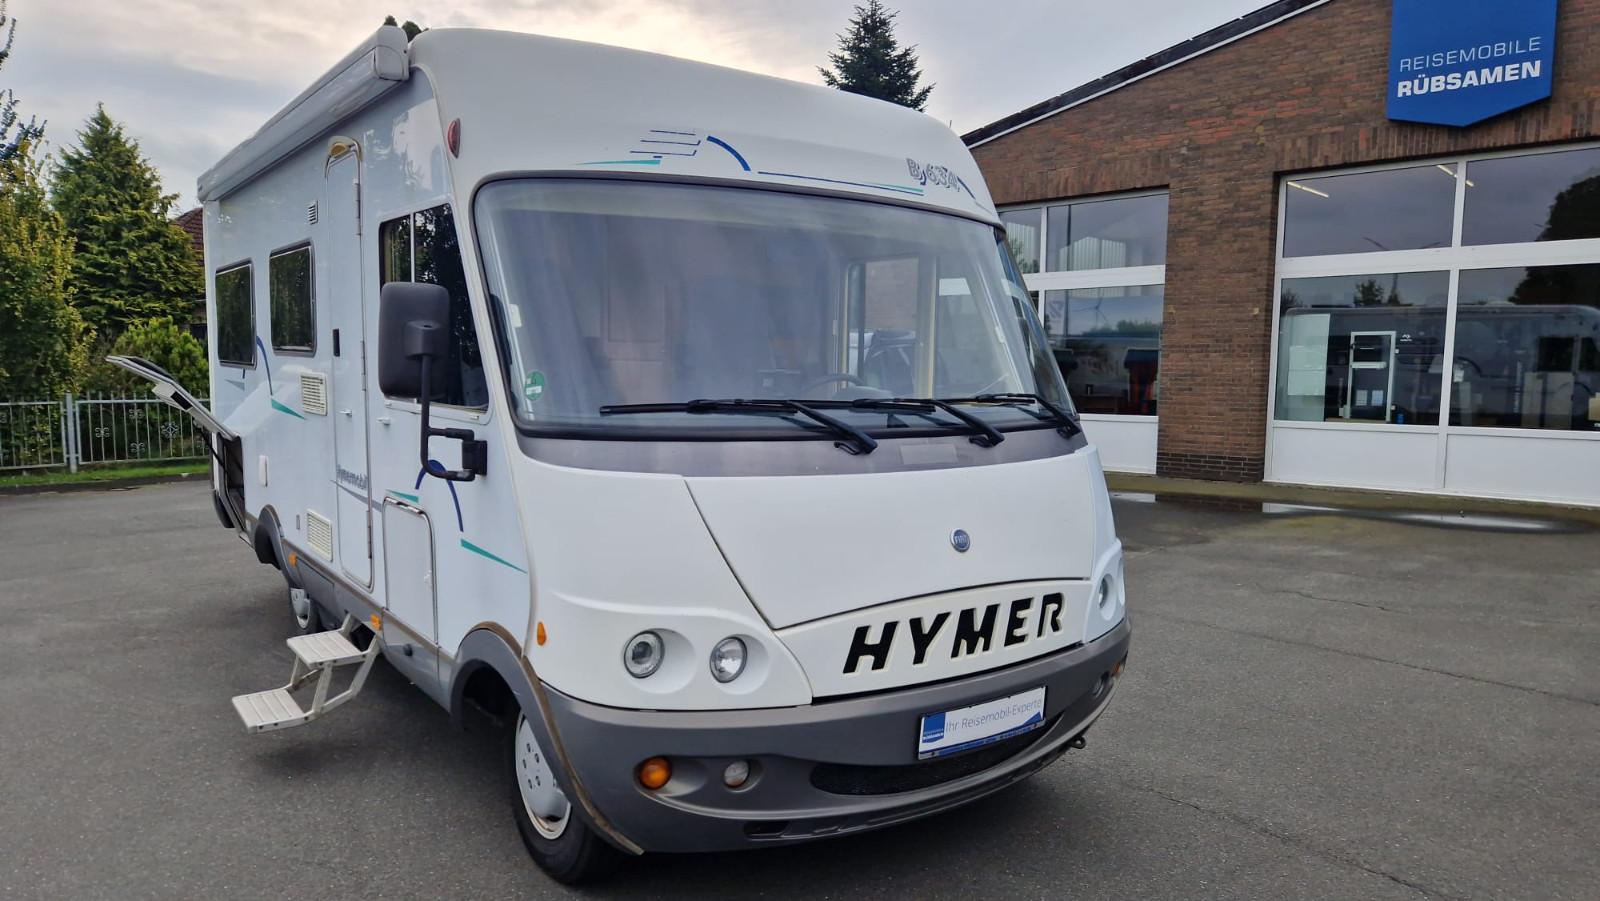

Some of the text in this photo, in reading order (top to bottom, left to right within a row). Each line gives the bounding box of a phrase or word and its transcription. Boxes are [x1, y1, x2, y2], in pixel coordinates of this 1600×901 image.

[1400, 36, 1542, 73] REISEMOBILE
[1397, 60, 1542, 98] RÜBSAMEN
[843, 592, 1064, 674] HYMER
[945, 698, 1042, 733] Ihr Reisemobil-Experte
